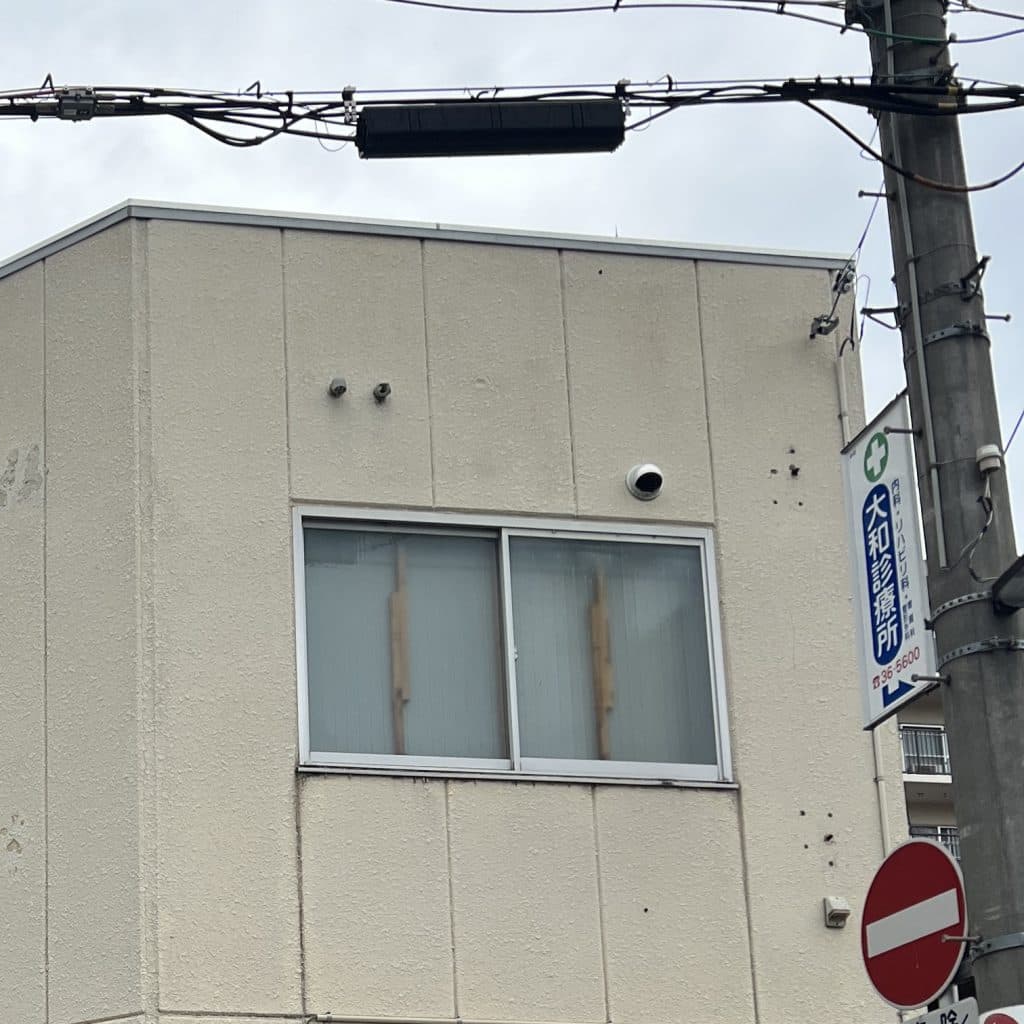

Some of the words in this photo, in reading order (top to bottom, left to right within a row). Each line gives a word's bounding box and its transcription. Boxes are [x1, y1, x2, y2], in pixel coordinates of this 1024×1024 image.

[865, 494, 899, 658] 大和診療所
